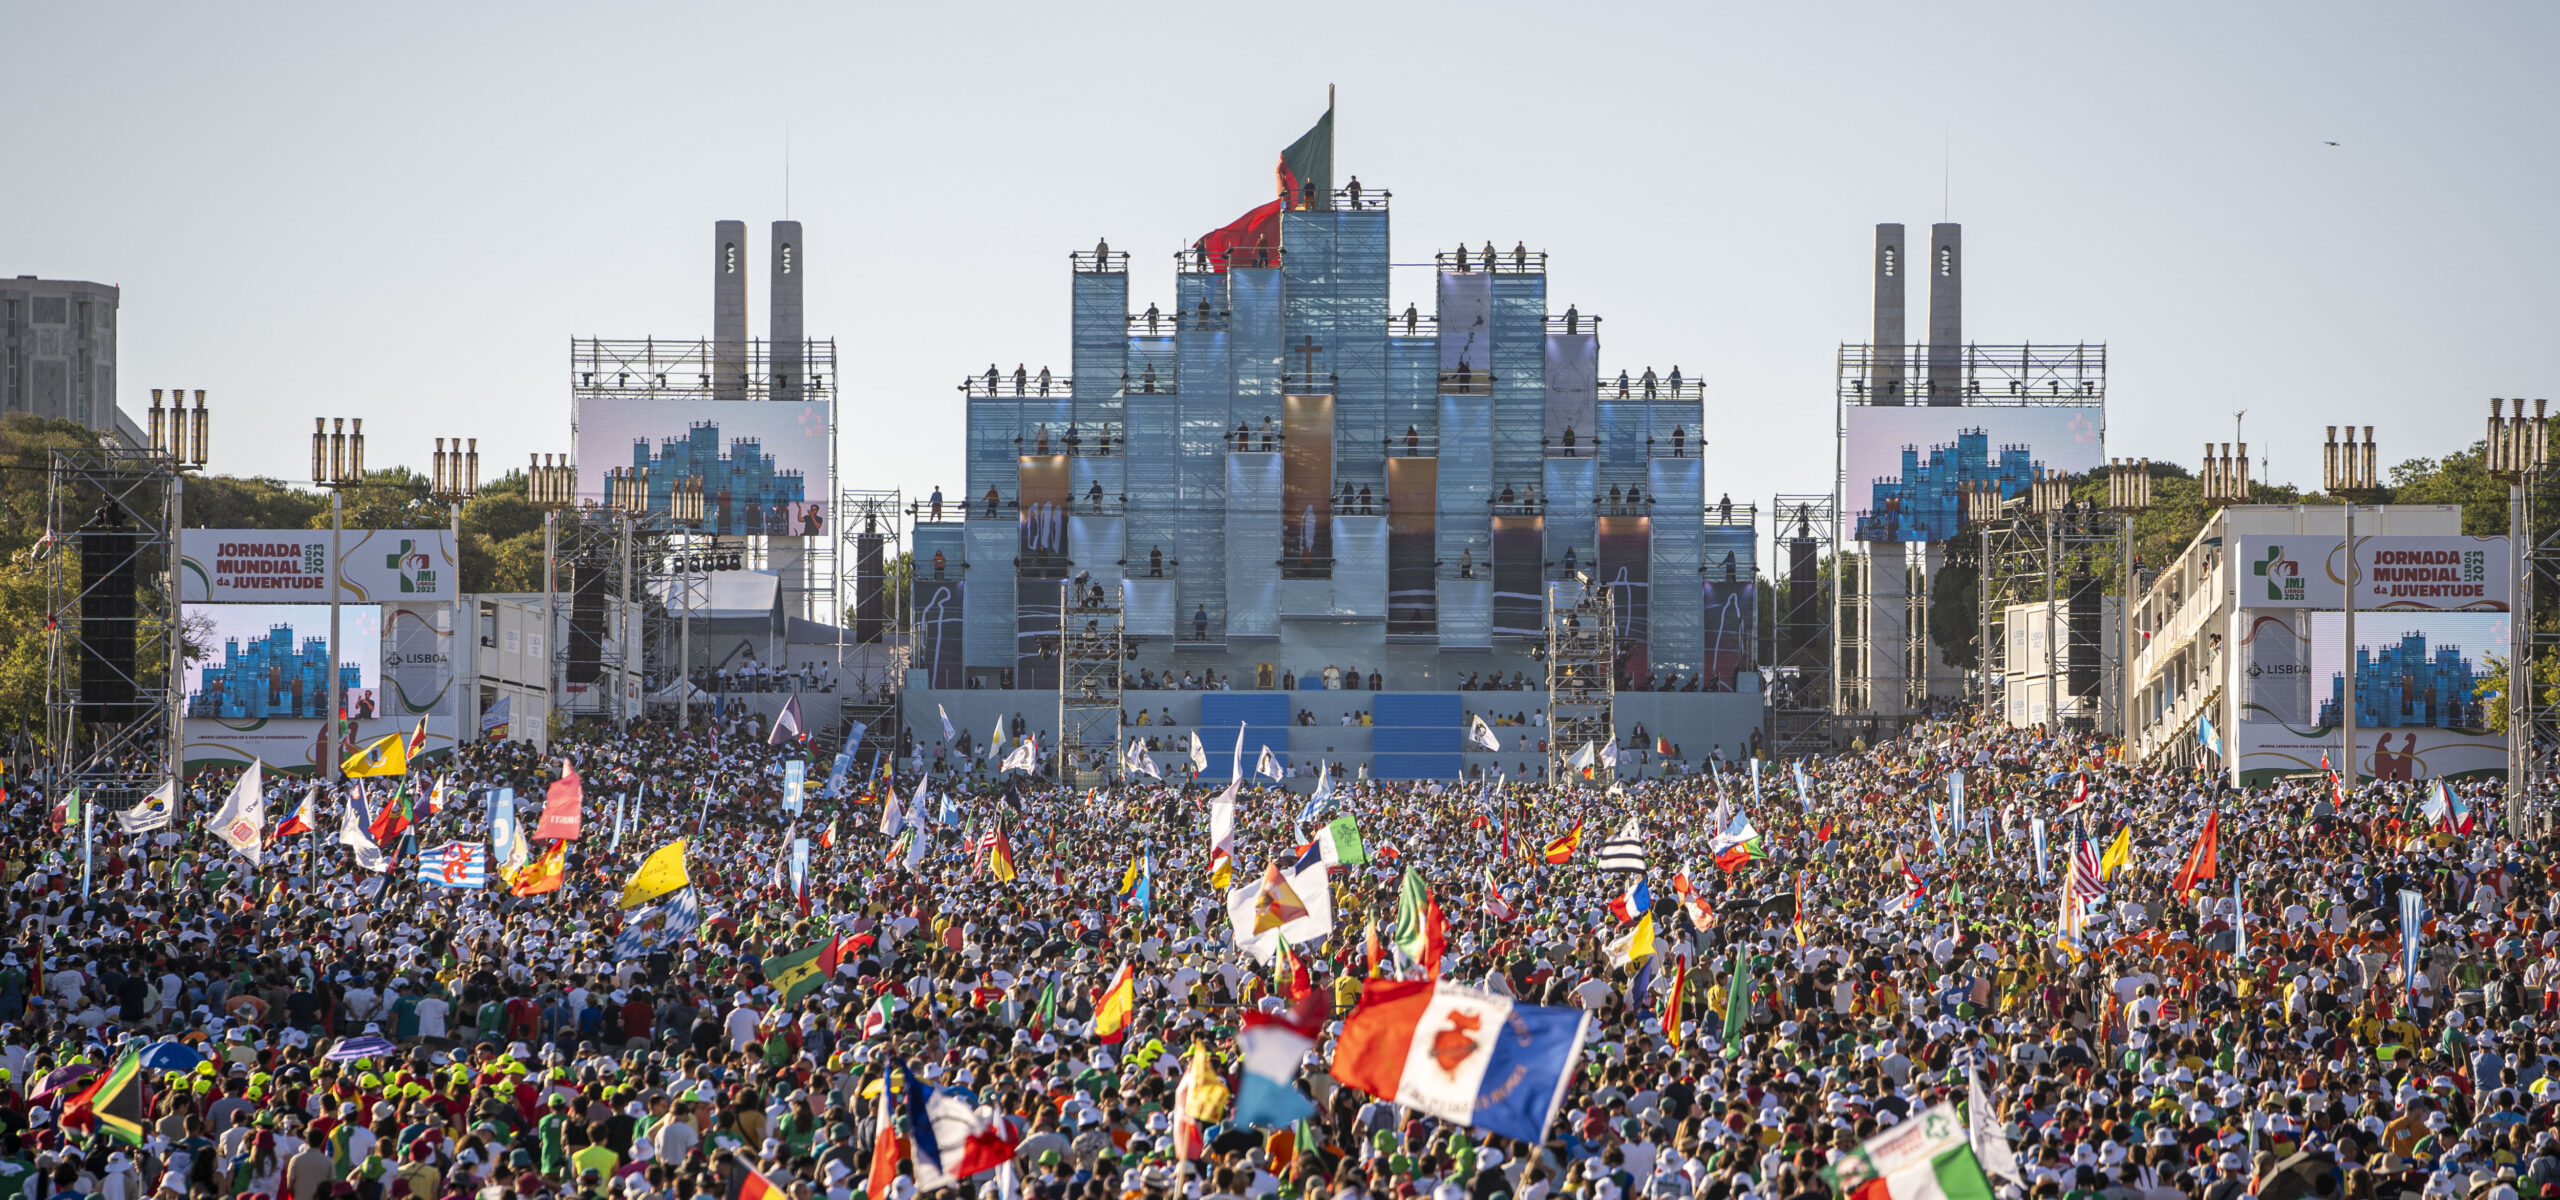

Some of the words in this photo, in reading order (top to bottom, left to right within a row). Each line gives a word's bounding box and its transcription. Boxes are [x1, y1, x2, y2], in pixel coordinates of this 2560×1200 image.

[217, 543, 302, 557] JORNADA
[304, 544, 313, 574] LISBOA
[313, 543, 324, 574] 2023
[2374, 550, 2461, 565] JORNADA
[216, 560, 302, 574] MUNDIAL
[2464, 551, 2472, 582] LISBOA
[2472, 550, 2484, 582] 2023
[416, 570, 436, 581] JMJ
[2373, 568, 2461, 582] MUNDIAL
[217, 577, 230, 586] da
[233, 576, 324, 589] JUVENTUDE
[2284, 577, 2305, 588] JMJ
[2374, 585, 2388, 594] da
[2390, 584, 2484, 597] JUVENTUDE
[406, 653, 448, 663] LISBOA
[2267, 664, 2310, 674] LISBOA
